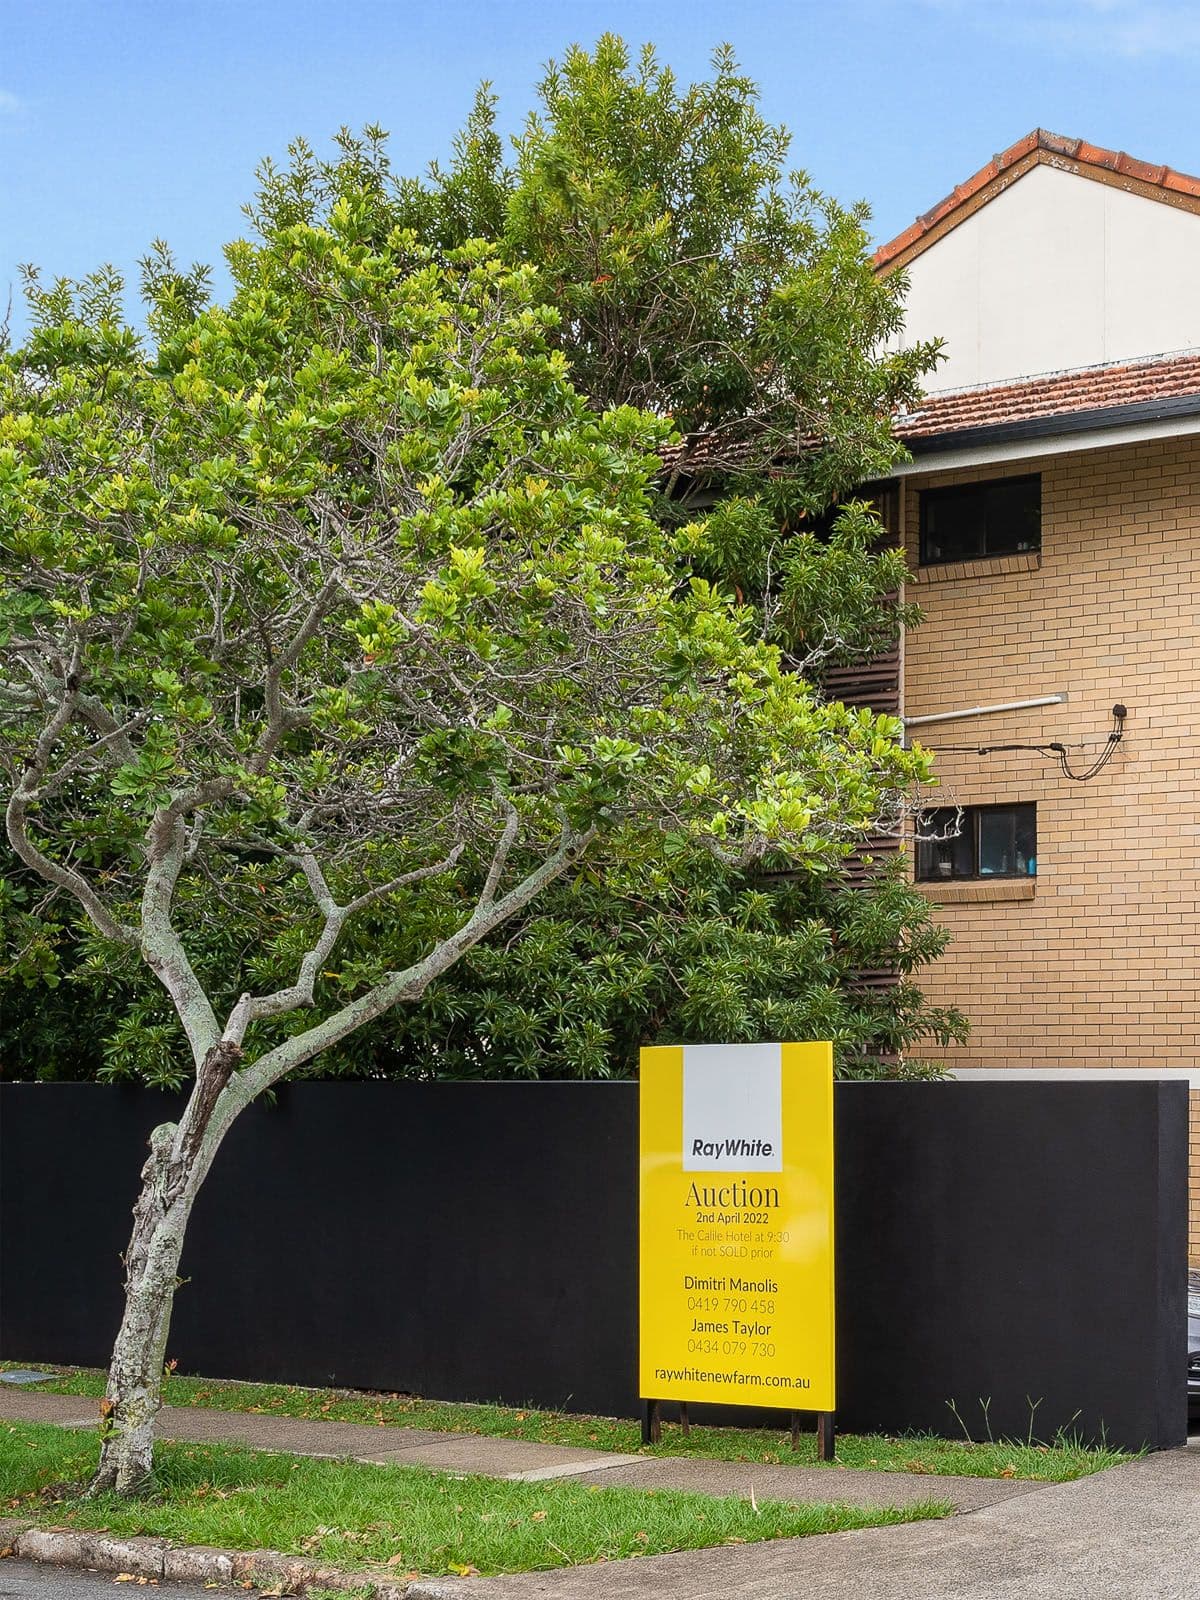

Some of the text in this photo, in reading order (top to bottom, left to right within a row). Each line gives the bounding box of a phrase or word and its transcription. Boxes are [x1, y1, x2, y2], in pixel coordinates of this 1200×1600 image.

[685, 1180, 780, 1208] Auction
[697, 1212, 769, 1225] 2nd April 2022
[677, 1229, 694, 1240] The
[726, 1230, 752, 1242] Hotel
[754, 1233, 764, 1242] at
[767, 1231, 789, 1243] 9:30
[692, 1245, 773, 1260] if not SOLD prior
[684, 1276, 778, 1293] Dimitri Manolis
[687, 1297, 775, 1314] 0419 790 458
[692, 1319, 771, 1337] James Taylor
[687, 1339, 775, 1357] 0434 079 730
[655, 1368, 810, 1388] raywhitenewfarm.com.au
